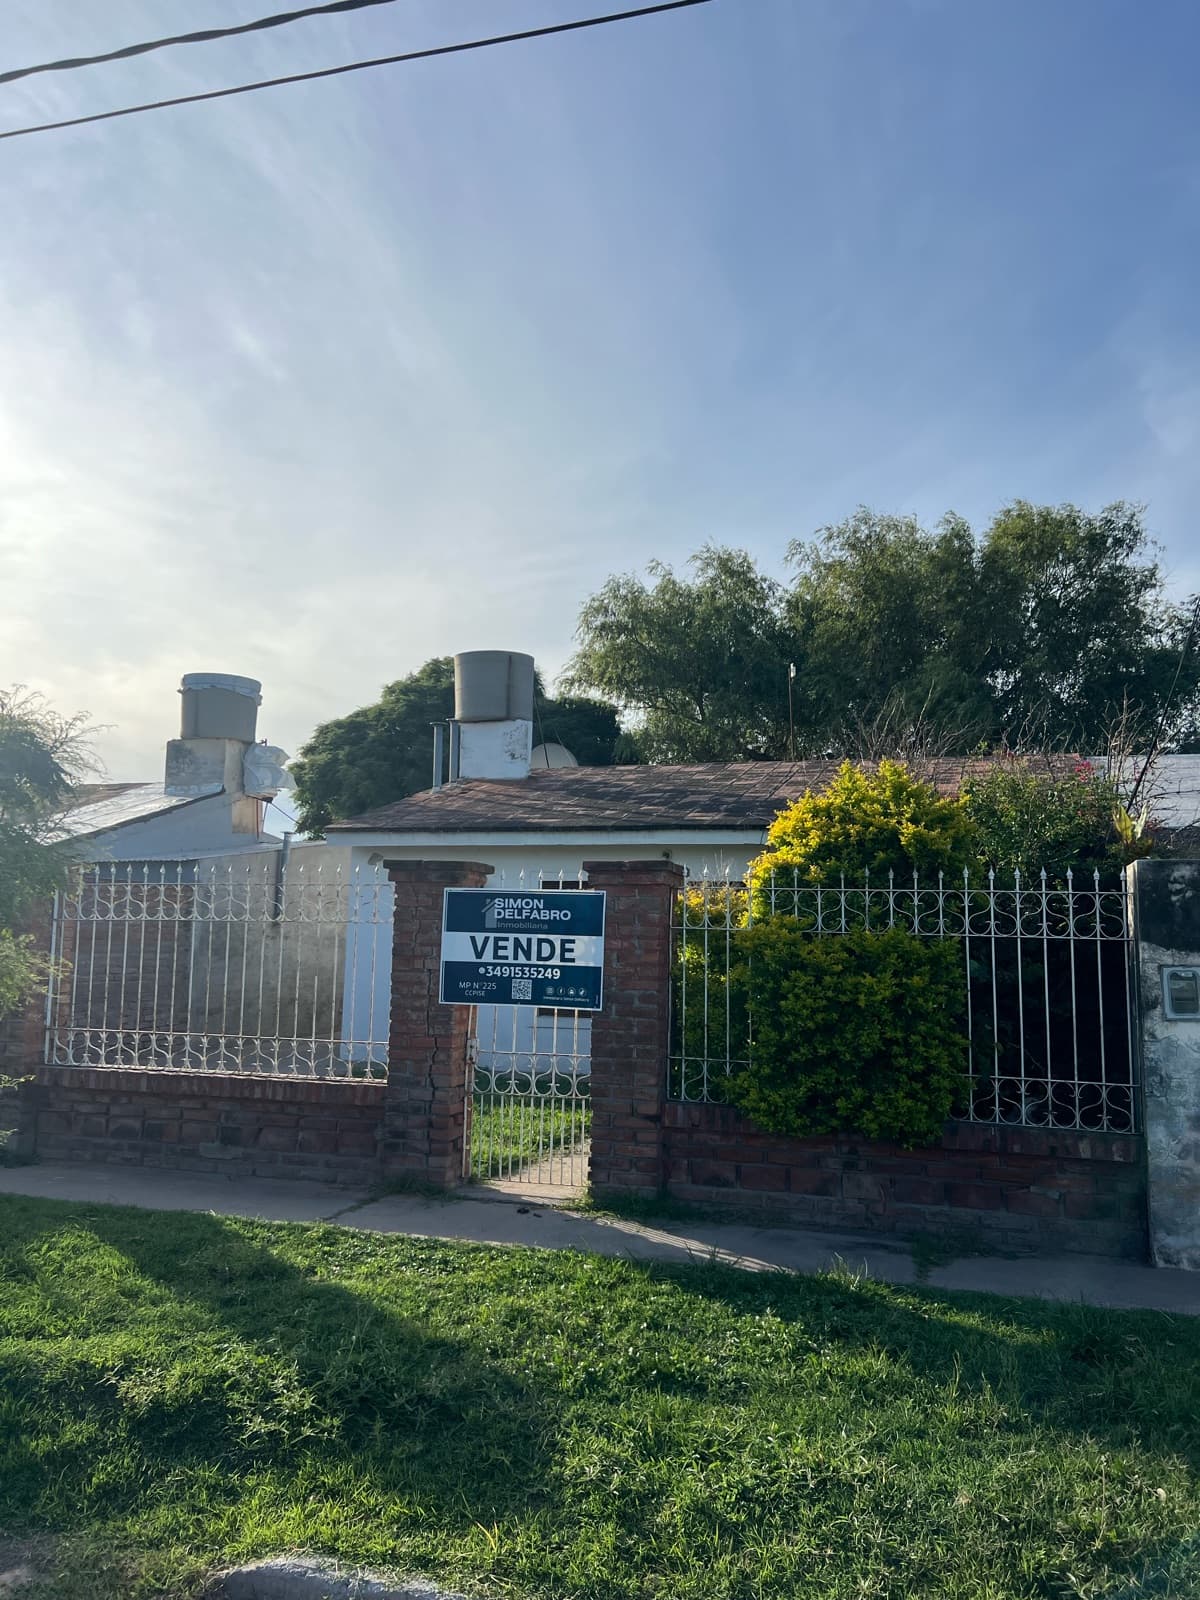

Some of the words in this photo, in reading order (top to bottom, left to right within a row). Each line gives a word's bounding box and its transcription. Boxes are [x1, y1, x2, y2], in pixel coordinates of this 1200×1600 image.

[494, 898, 543, 909] SIMON
[494, 909, 571, 920] DELFABRO
[497, 921, 548, 930] Inmobiliaria
[470, 935, 576, 963] VENDE
[485, 965, 560, 979] 3491535249
[459, 981, 471, 989] MP
[482, 982, 497, 990] 225
